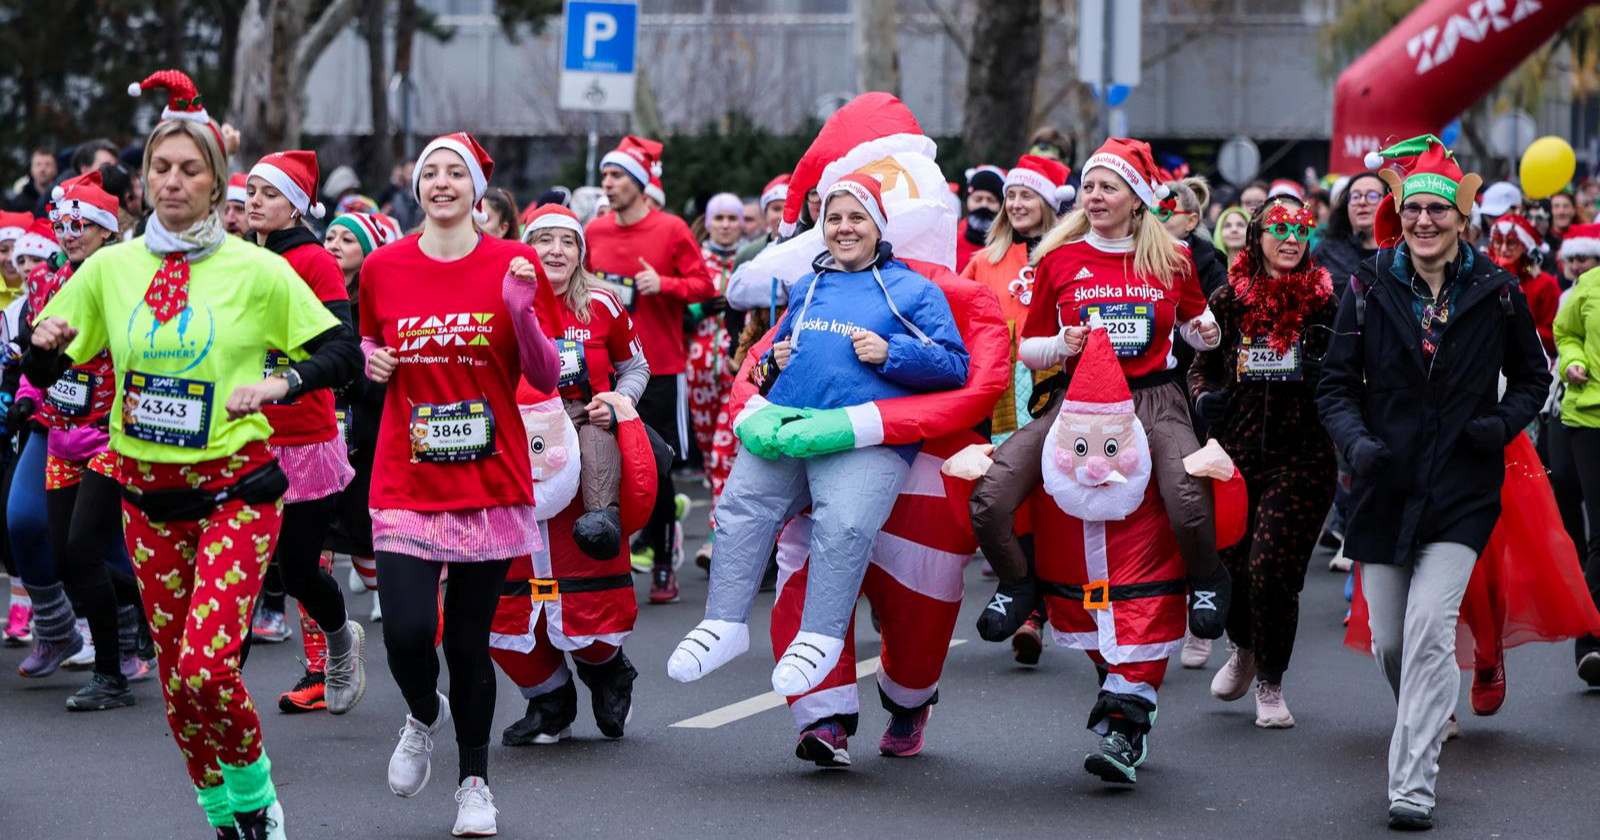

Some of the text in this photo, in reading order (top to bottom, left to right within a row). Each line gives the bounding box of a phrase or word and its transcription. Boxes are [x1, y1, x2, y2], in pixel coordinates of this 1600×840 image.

[583, 11, 618, 59] P
[1120, 163, 1140, 186] knjiga
[1427, 176, 1455, 194] Helper
[1074, 284, 1164, 302] školska knjiga
[406, 328, 436, 338] GODINA
[437, 326, 448, 334] ZA
[449, 325, 476, 333] JEDAN
[477, 325, 493, 333] CILJ
[801, 317, 829, 331] olska
[564, 326, 591, 341] jiga
[143, 350, 196, 360] RUNNERS
[419, 356, 450, 364] CROATIA
[141, 399, 187, 418] 4343
[432, 423, 472, 438] 3846
